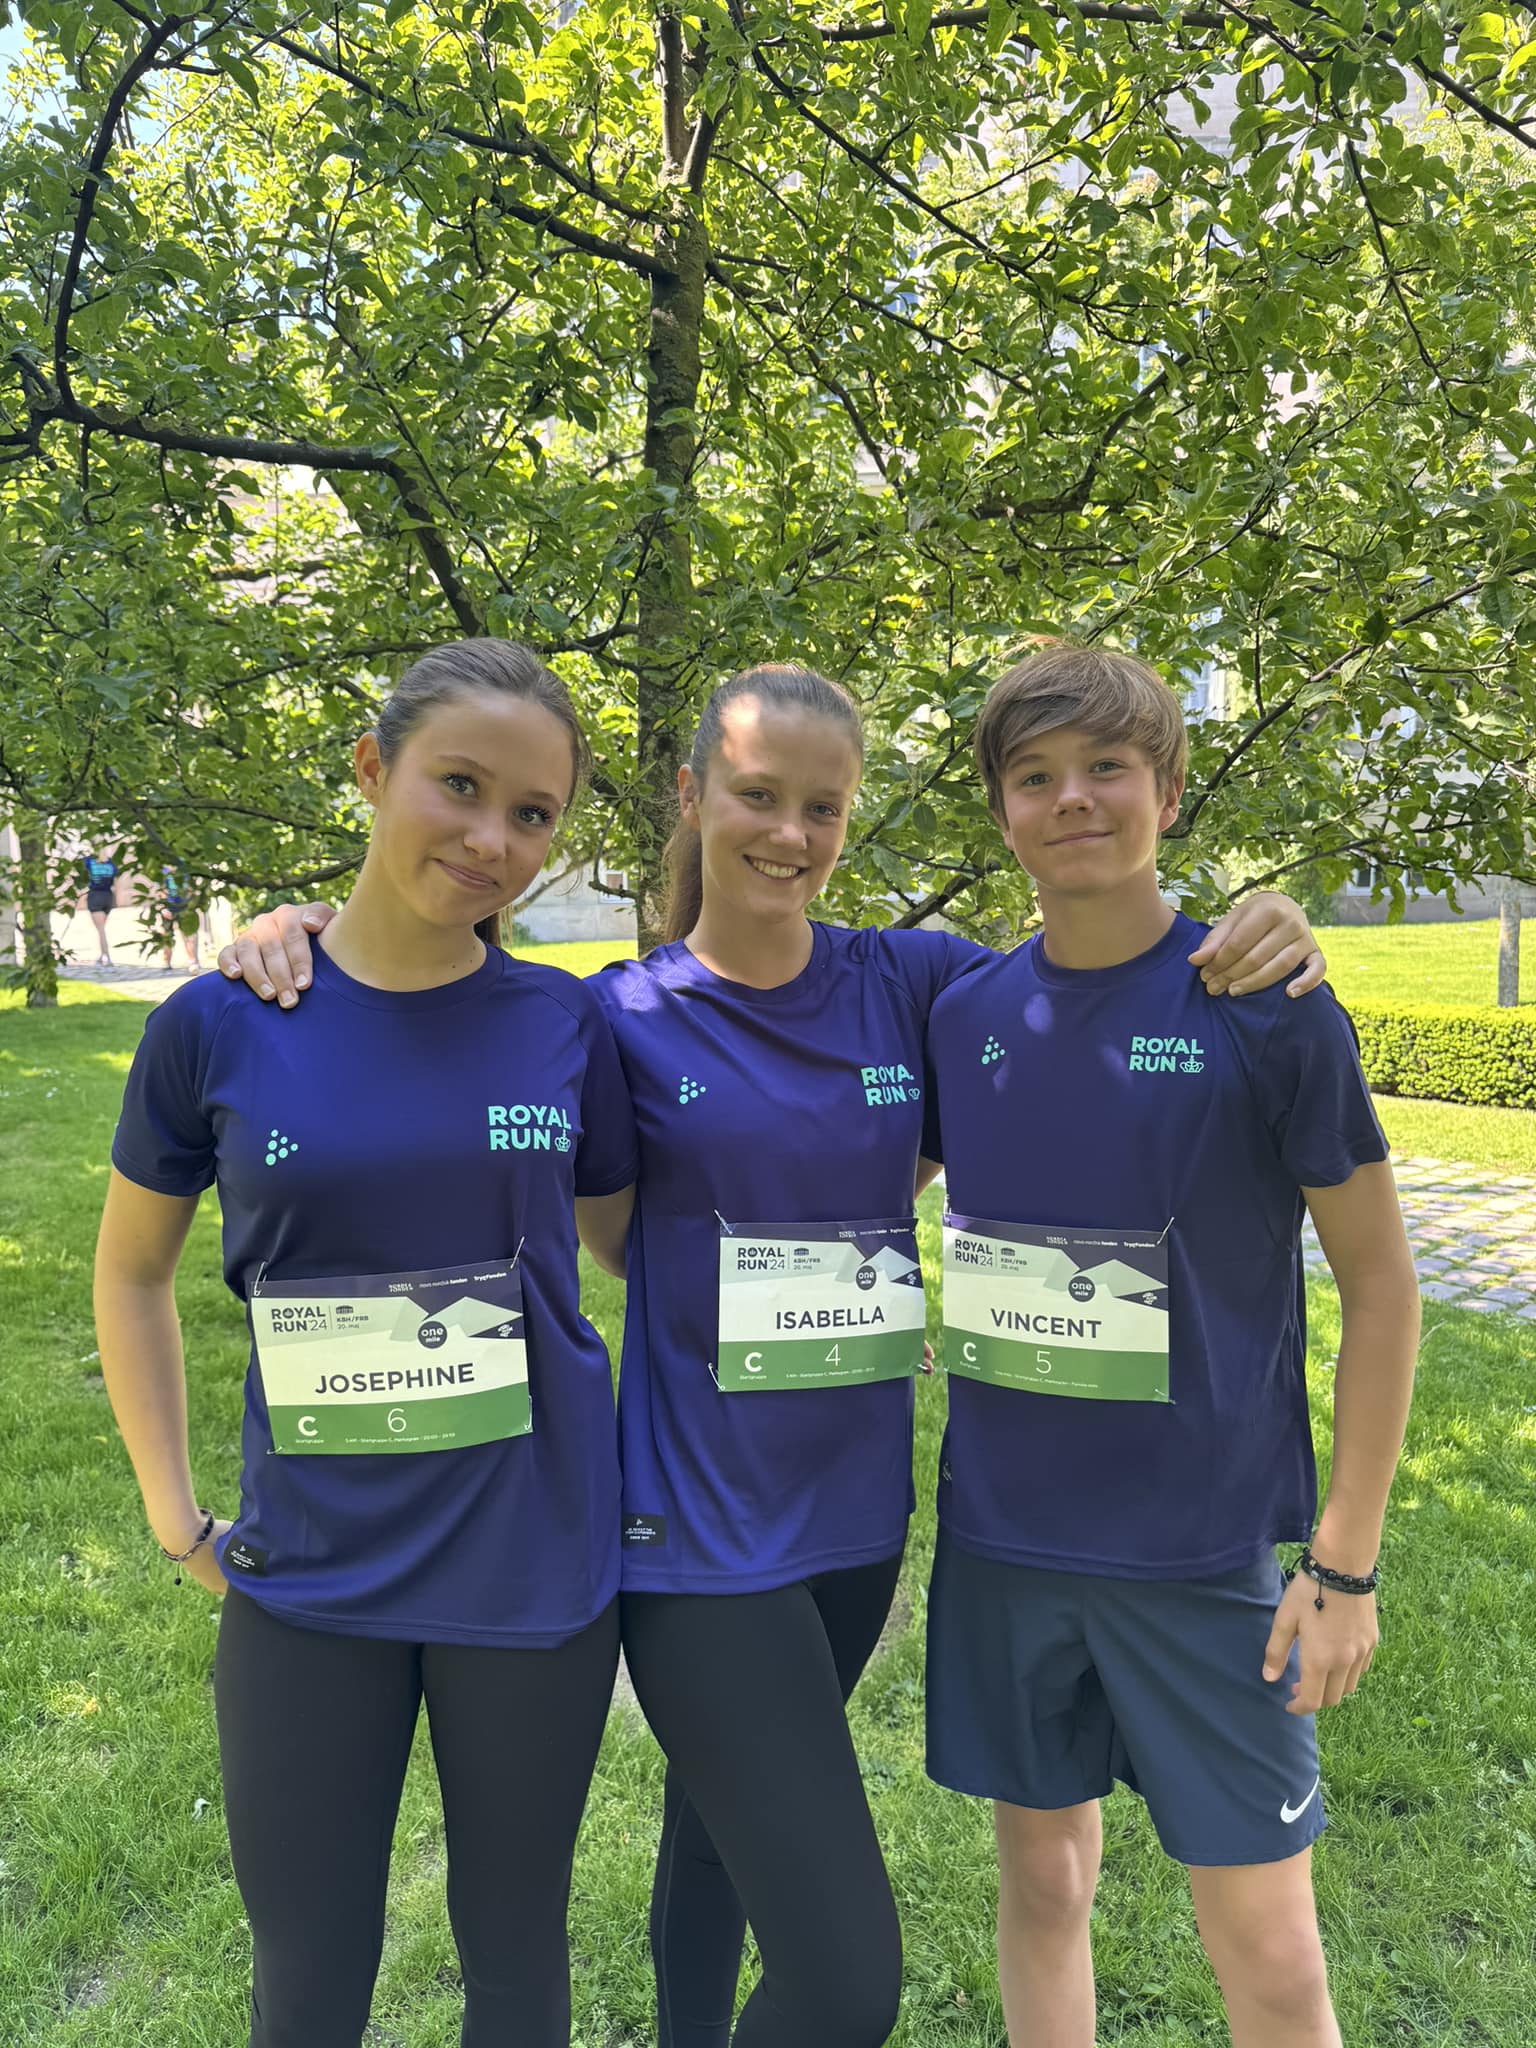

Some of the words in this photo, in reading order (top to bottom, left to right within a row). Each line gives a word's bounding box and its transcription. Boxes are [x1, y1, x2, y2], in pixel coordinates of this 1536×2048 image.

[1131, 1036, 1204, 1054] ROYAL
[1129, 1055, 1176, 1072] RUN
[861, 1064, 914, 1086] ROYA
[865, 1085, 907, 1106] RUN
[488, 1105, 572, 1129] ROYAL
[489, 1128, 551, 1150] RUN
[737, 1247, 785, 1257] ROYAL
[954, 1238, 993, 1255] ROYAL
[858, 1271, 874, 1279] one
[1071, 1282, 1093, 1291] one
[271, 1306, 327, 1319] ROYAL
[776, 1306, 885, 1330] ISABELLA
[990, 1307, 1102, 1338] VINCENT
[421, 1327, 444, 1337] one
[744, 1351, 763, 1373] C
[825, 1343, 841, 1366] 4
[963, 1341, 977, 1362] C
[1035, 1350, 1052, 1374] 5
[315, 1362, 475, 1394] JOSEPHINE
[297, 1415, 319, 1437] C
[387, 1407, 407, 1433] 6
